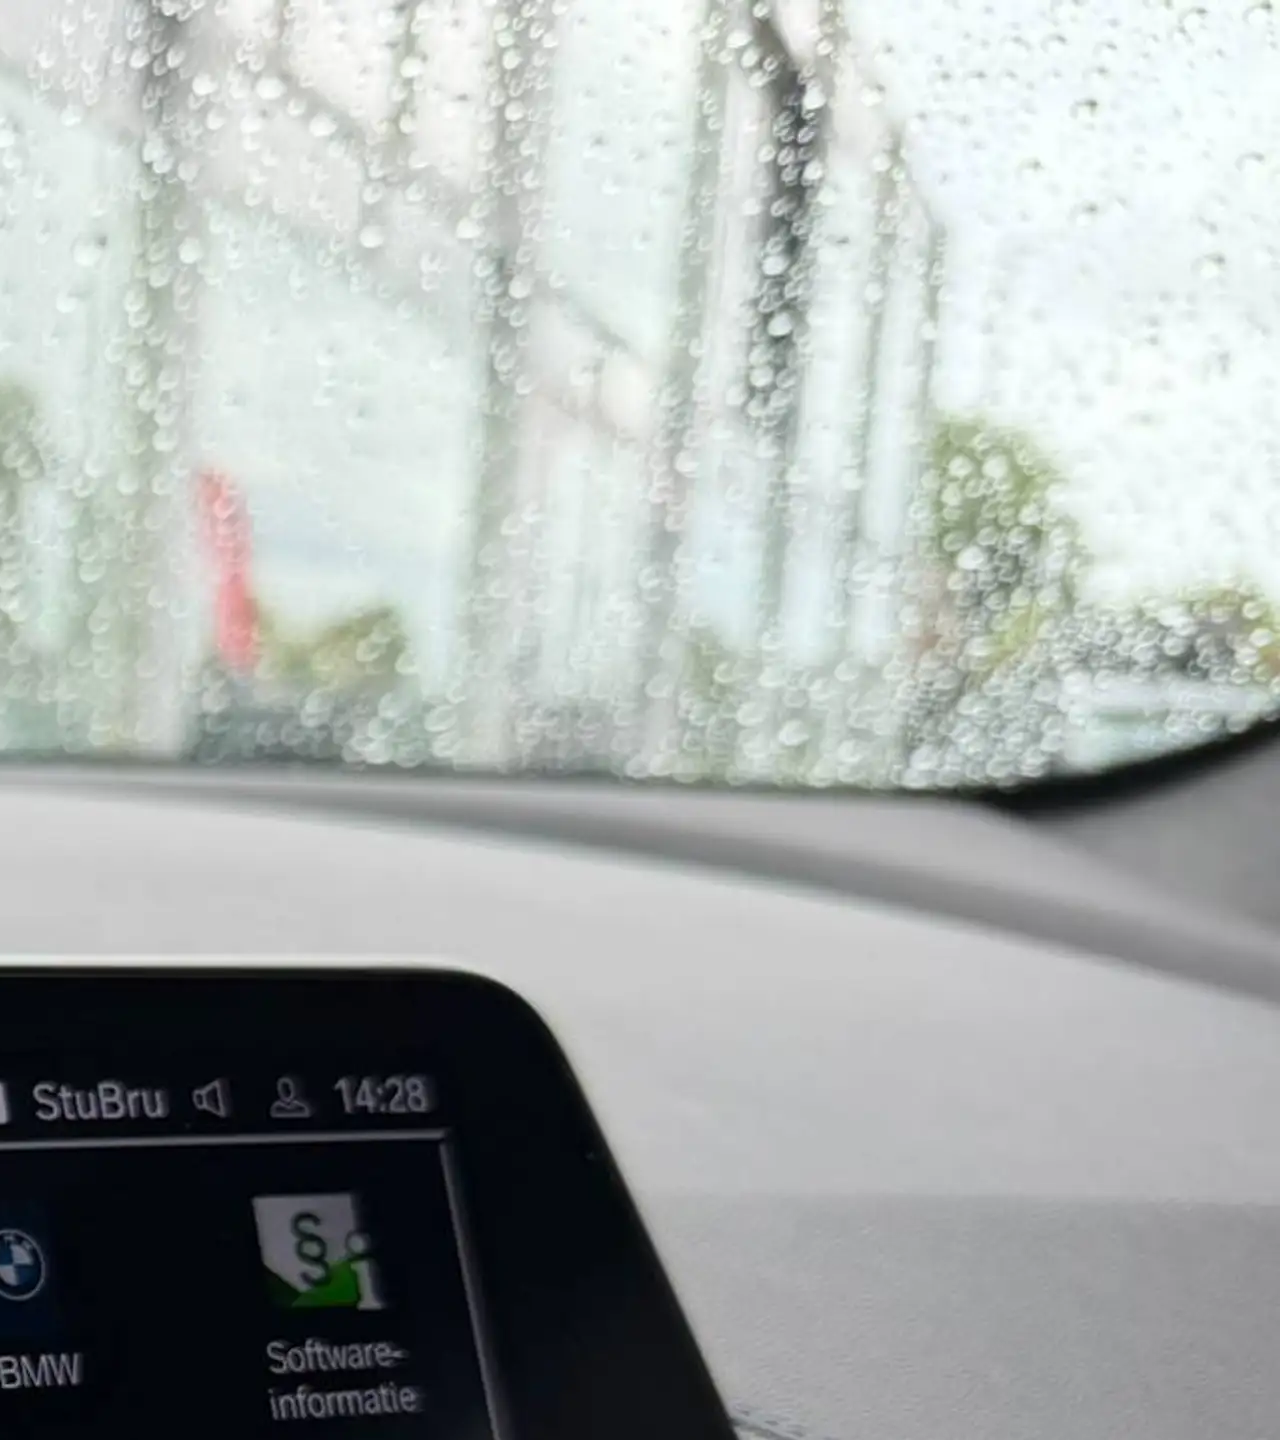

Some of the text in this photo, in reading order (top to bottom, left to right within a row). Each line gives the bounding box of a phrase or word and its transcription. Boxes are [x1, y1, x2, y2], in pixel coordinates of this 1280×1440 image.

[32, 1081, 166, 1121] StuBru
[335, 1076, 431, 1114] 14:28
[267, 1338, 405, 1374] Software-
[269, 1382, 420, 1420] informatie
